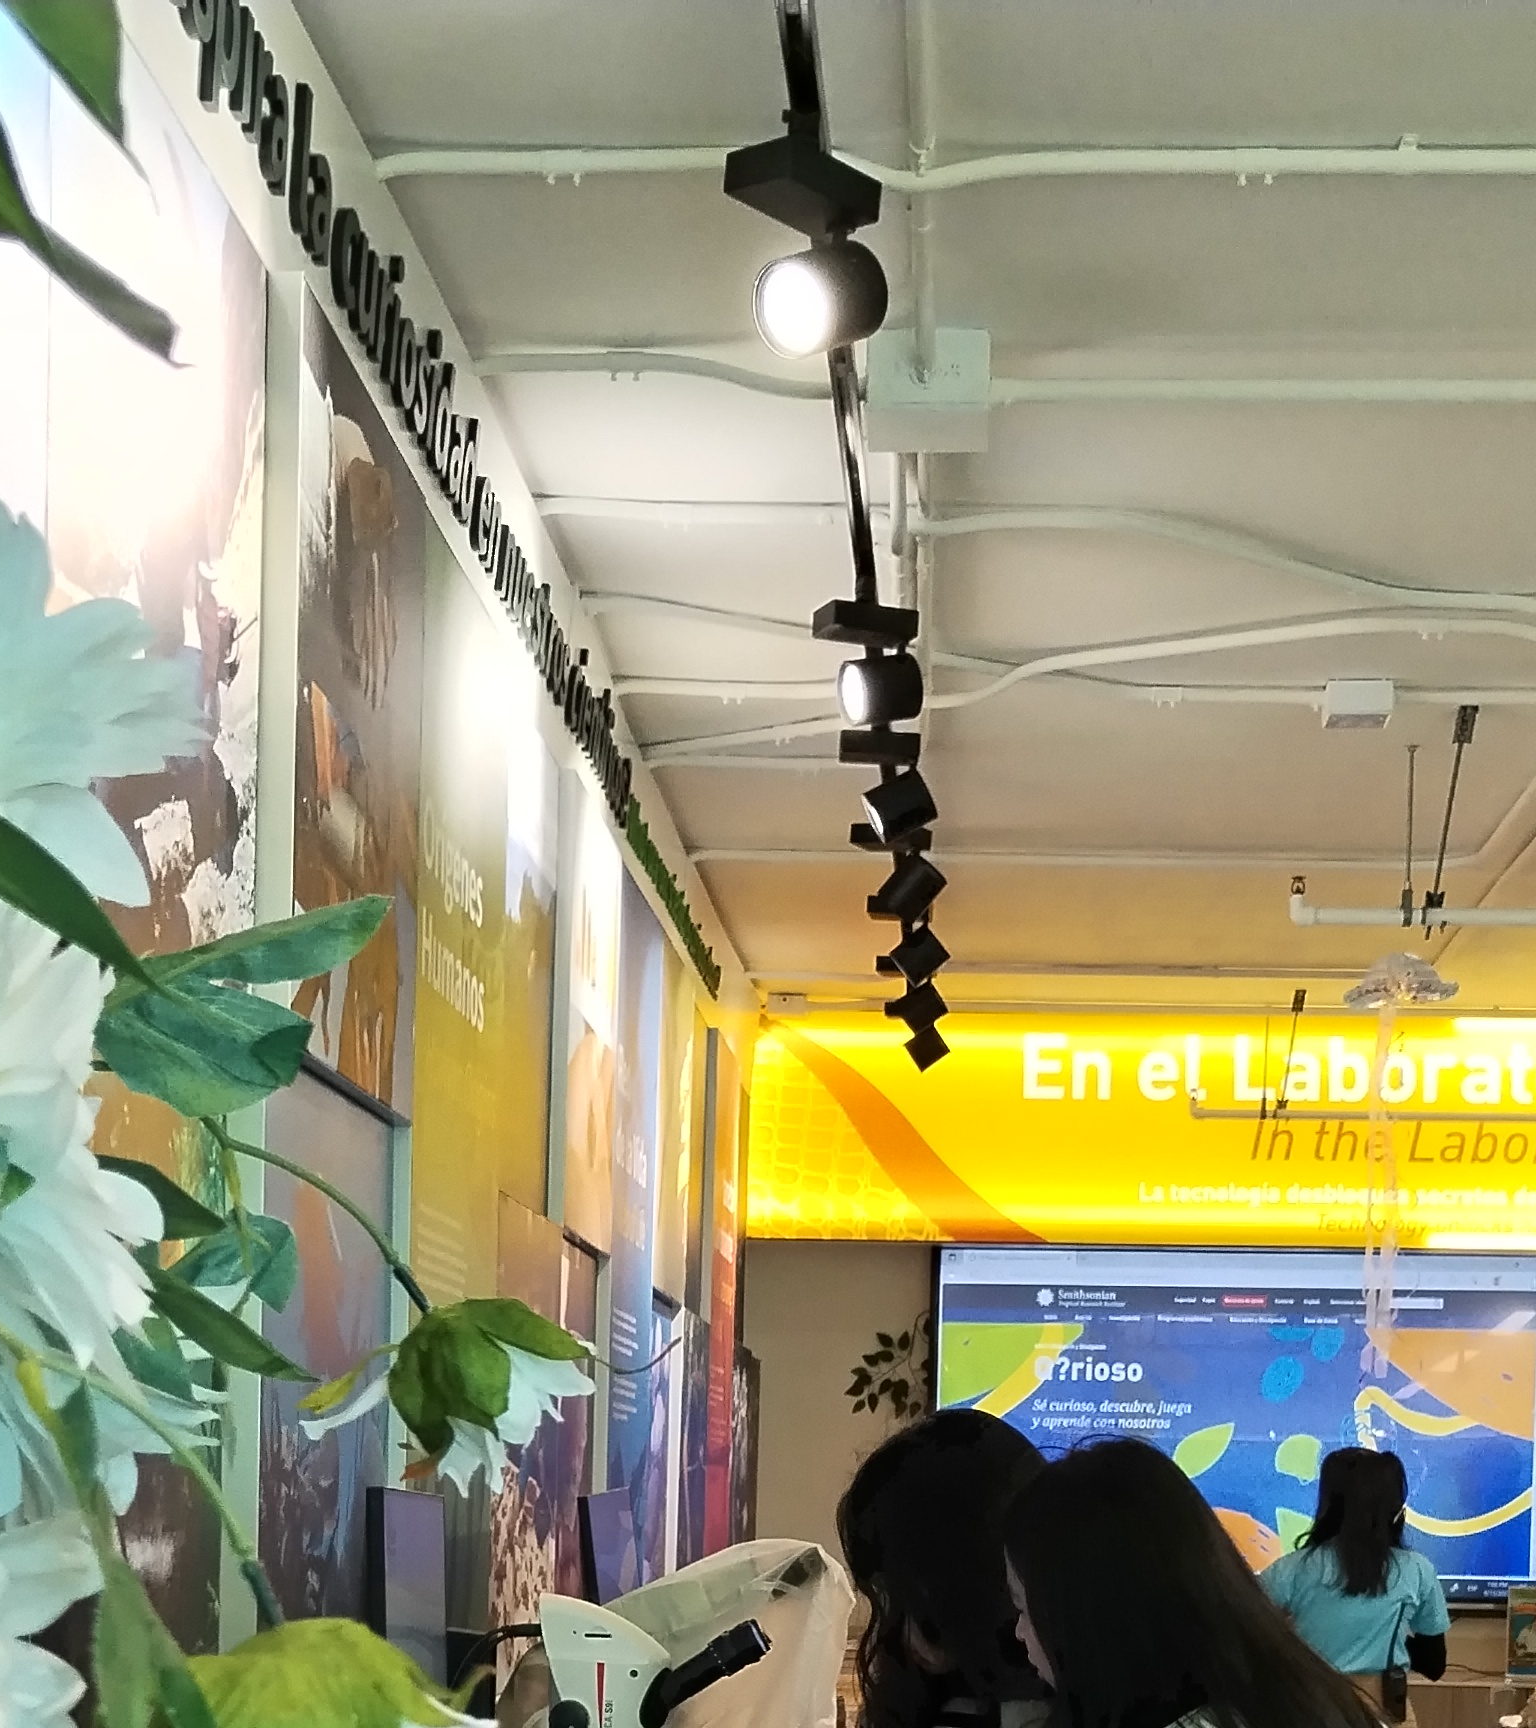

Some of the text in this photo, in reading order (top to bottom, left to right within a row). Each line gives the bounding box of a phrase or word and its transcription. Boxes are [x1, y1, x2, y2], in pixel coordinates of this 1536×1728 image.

[289, 83, 332, 267] la
[330, 207, 480, 526] curiosidad
[469, 476, 501, 578] en
[421, 906, 485, 1034] Humanos
[1022, 1034, 1112, 1101] En
[1136, 1033, 1202, 1101] el
[1251, 1119, 1295, 1162] In
[1313, 1119, 1387, 1163] the
[1138, 1181, 1164, 1204] La
[1170, 1181, 1281, 1208] tecnología
[1058, 1289, 1117, 1301] Smithsonian
[1030, 1416, 1171, 1431] y aprende con nosotros
[1032, 1398, 1047, 1412] Sé
[1049, 1399, 1097, 1414] curioso,
[1157, 1400, 1192, 1416] juega
